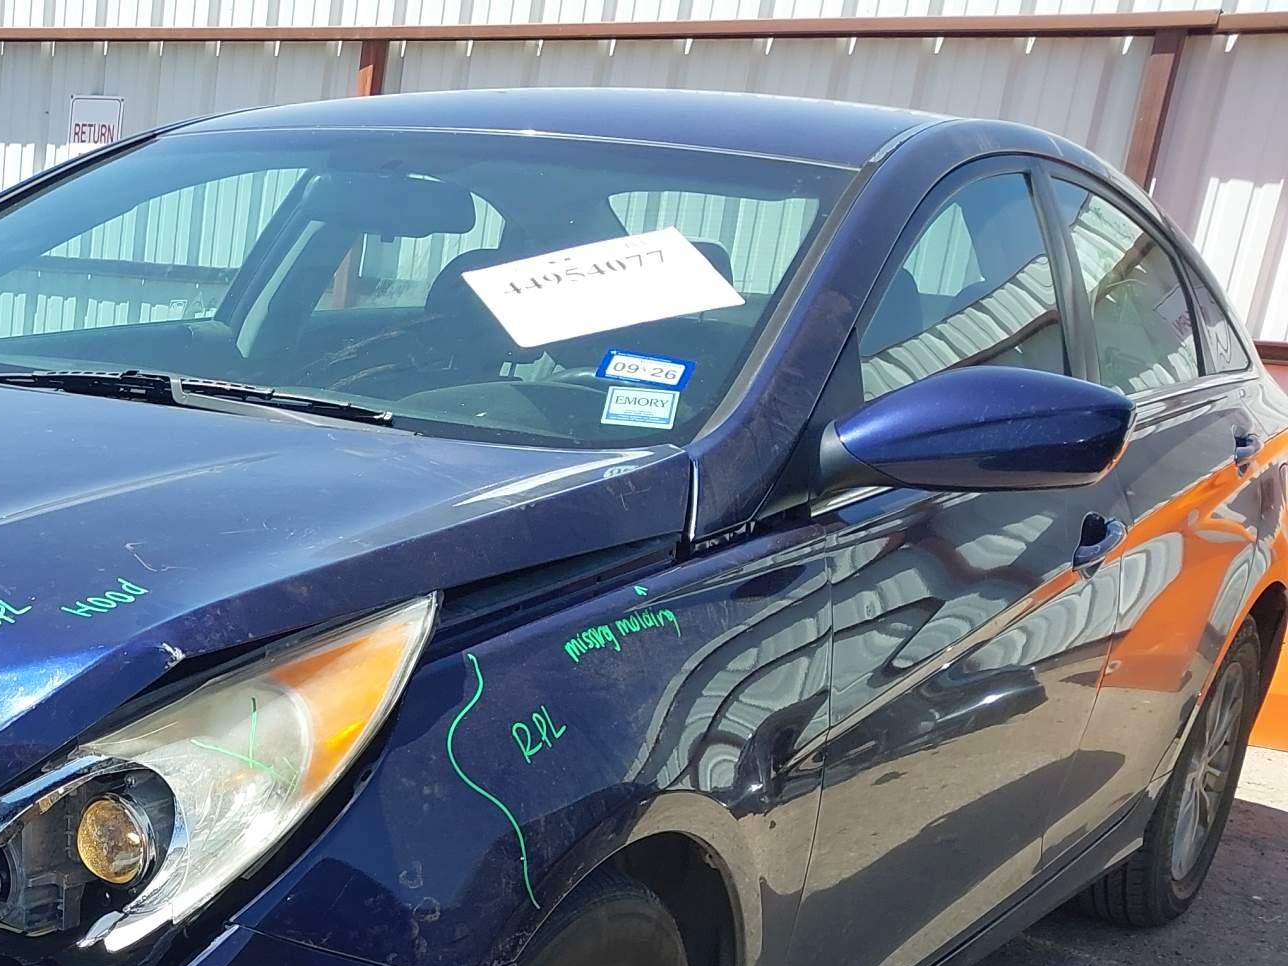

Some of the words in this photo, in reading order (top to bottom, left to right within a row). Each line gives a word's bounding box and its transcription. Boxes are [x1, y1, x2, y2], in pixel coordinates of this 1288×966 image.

[73, 123, 115, 144] RETURN
[504, 250, 664, 294] 44954077
[613, 361, 640, 374] 09
[650, 367, 678, 380] 26
[615, 395, 669, 408] EMORY
[512, 704, 567, 765] RPL
